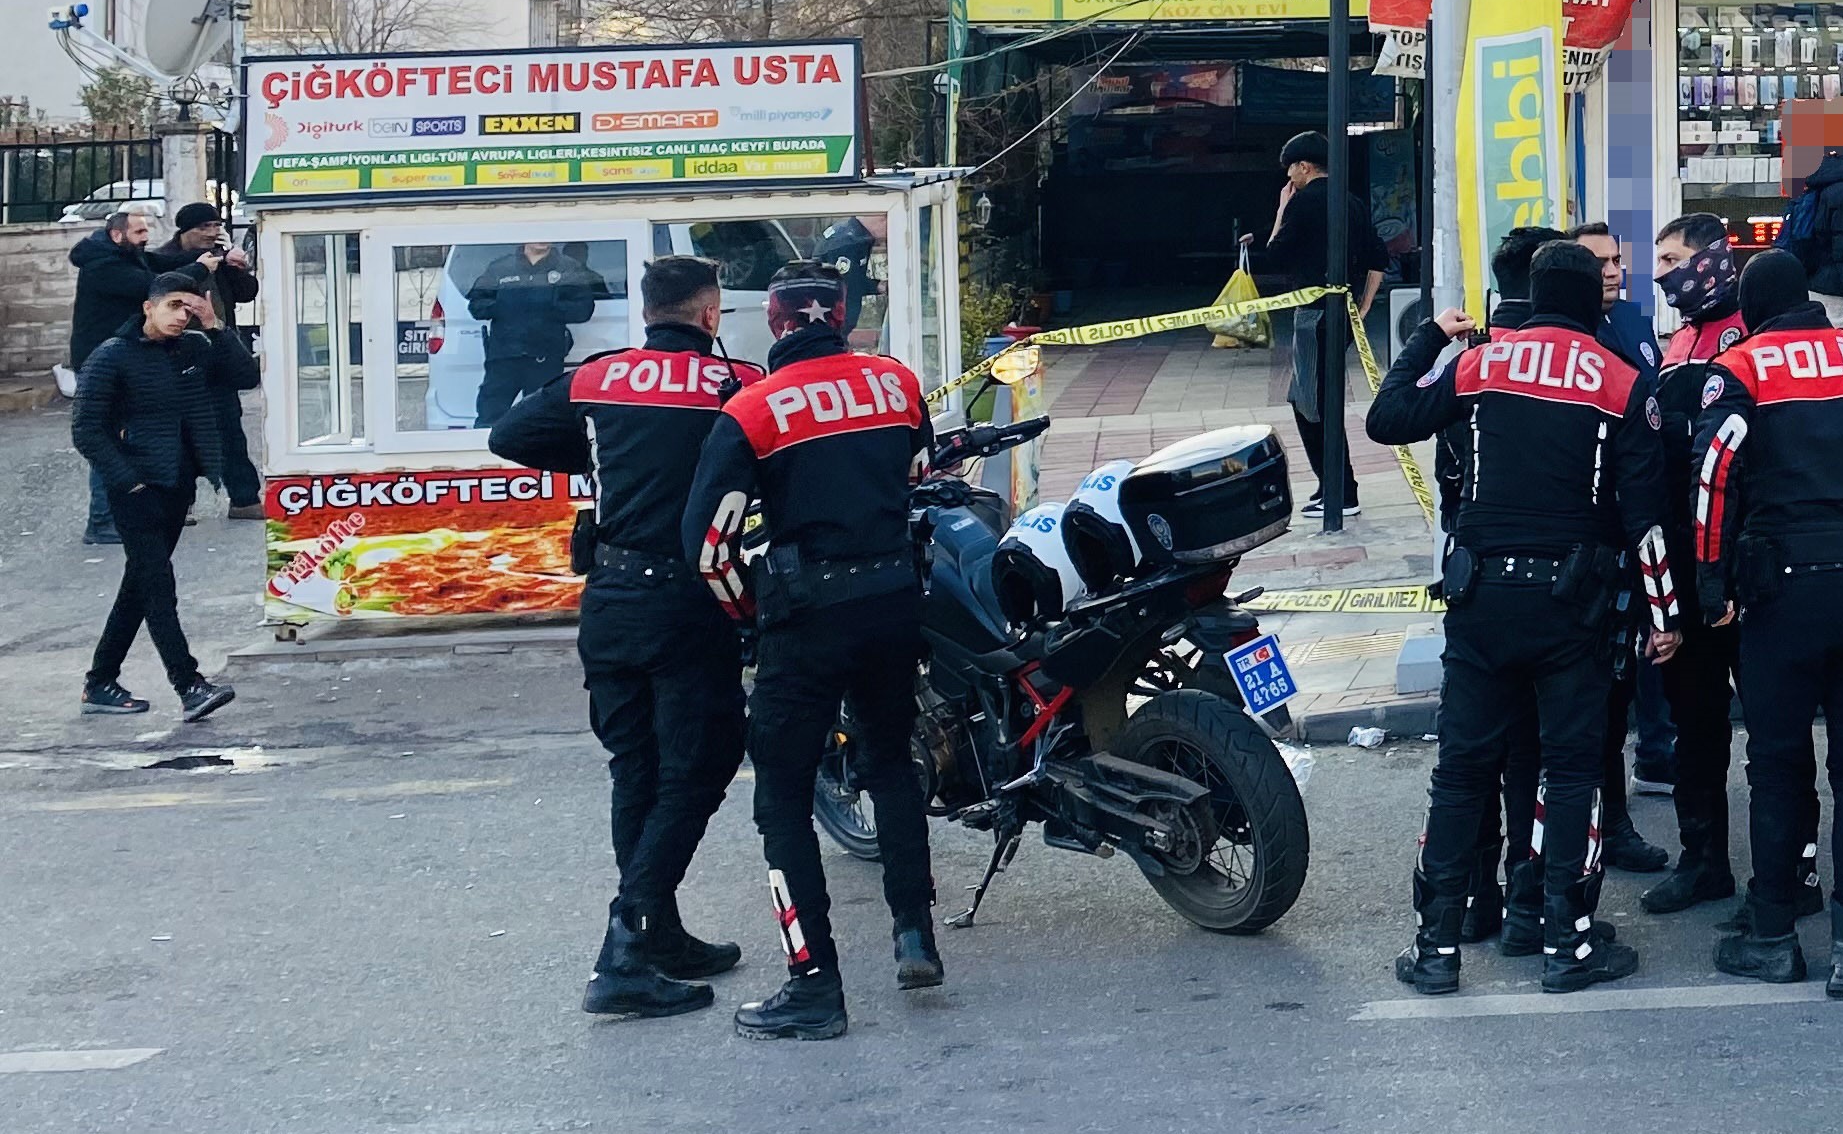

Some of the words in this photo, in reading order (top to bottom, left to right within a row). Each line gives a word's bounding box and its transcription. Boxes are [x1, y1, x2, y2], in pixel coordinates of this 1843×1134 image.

[527, 57, 720, 94] MUSTAFA
[733, 54, 842, 86] USTA
[415, 118, 463, 134] SPORTS
[768, 108, 821, 123] piyango
[471, 150, 524, 161] AVRUPA
[656, 144, 695, 155] CANLI
[773, 139, 827, 151] BURADA
[693, 160, 738, 174] iddaa
[1243, 670, 1264, 691] 21
[1269, 661, 1283, 679] A
[1252, 677, 1289, 707] 4765
